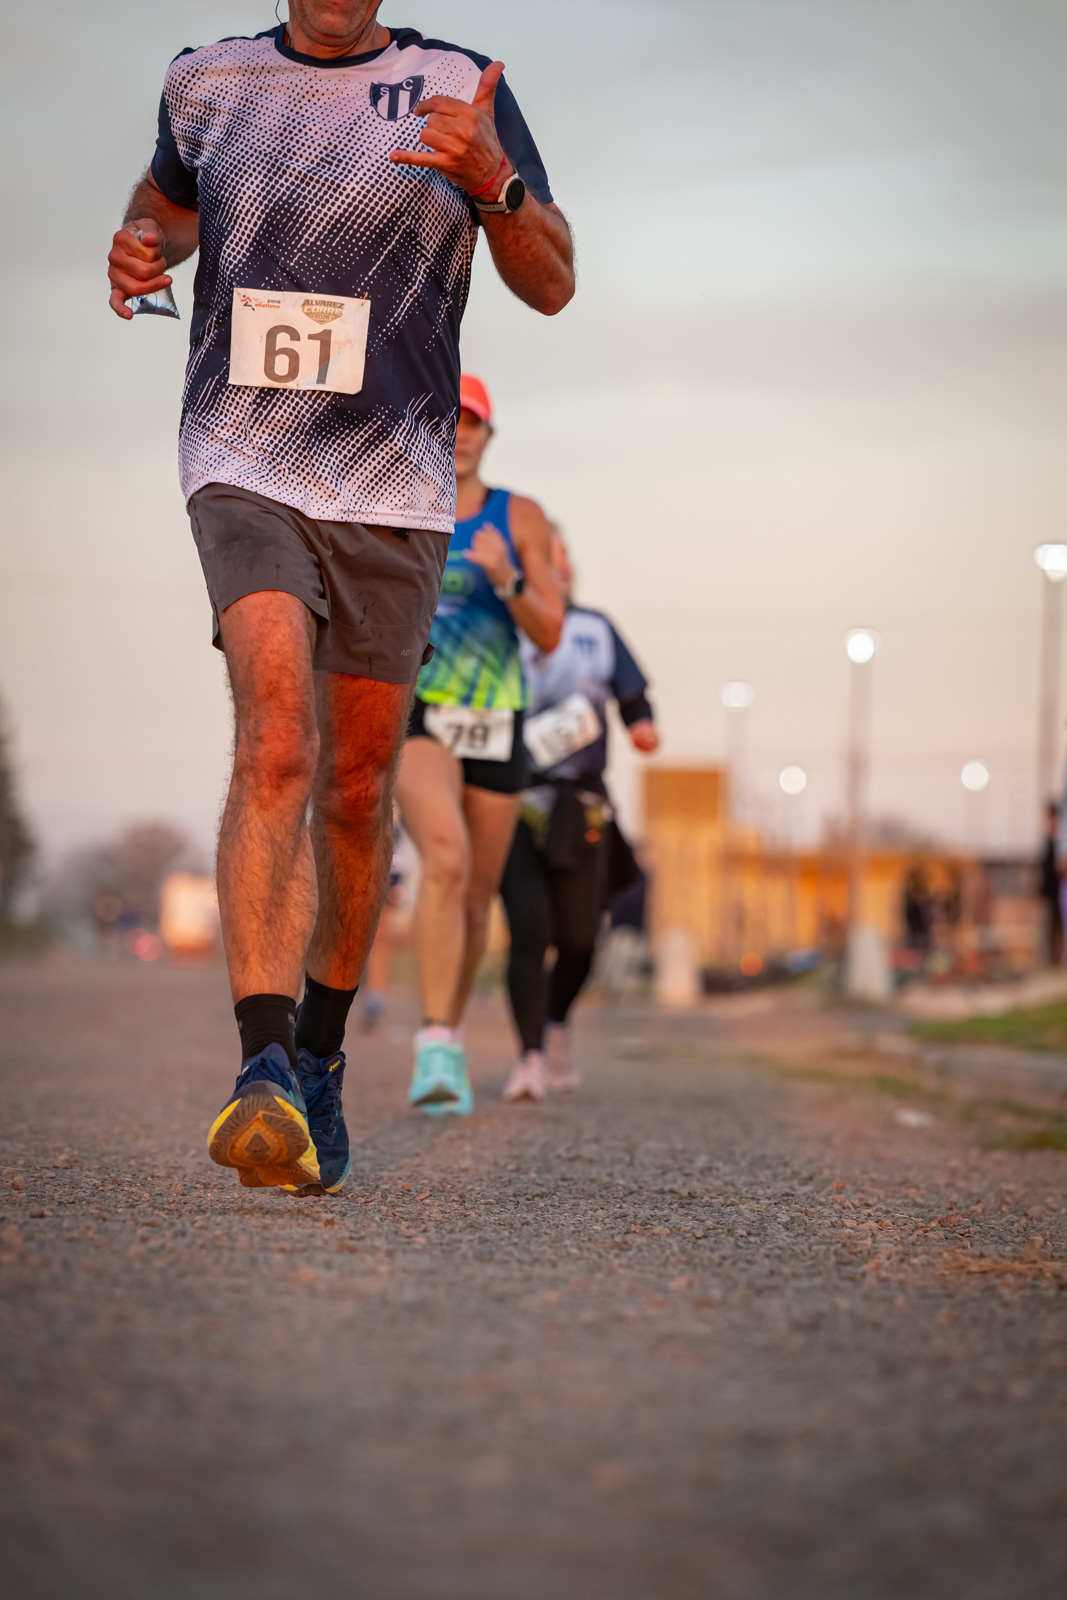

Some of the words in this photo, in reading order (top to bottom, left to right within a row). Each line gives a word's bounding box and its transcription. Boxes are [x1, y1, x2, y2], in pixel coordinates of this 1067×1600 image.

[380, 86, 390, 96] S
[402, 78, 413, 90] C
[301, 299, 345, 309] ALVAREZ
[303, 305, 343, 315] CORRE
[263, 324, 332, 385] 61
